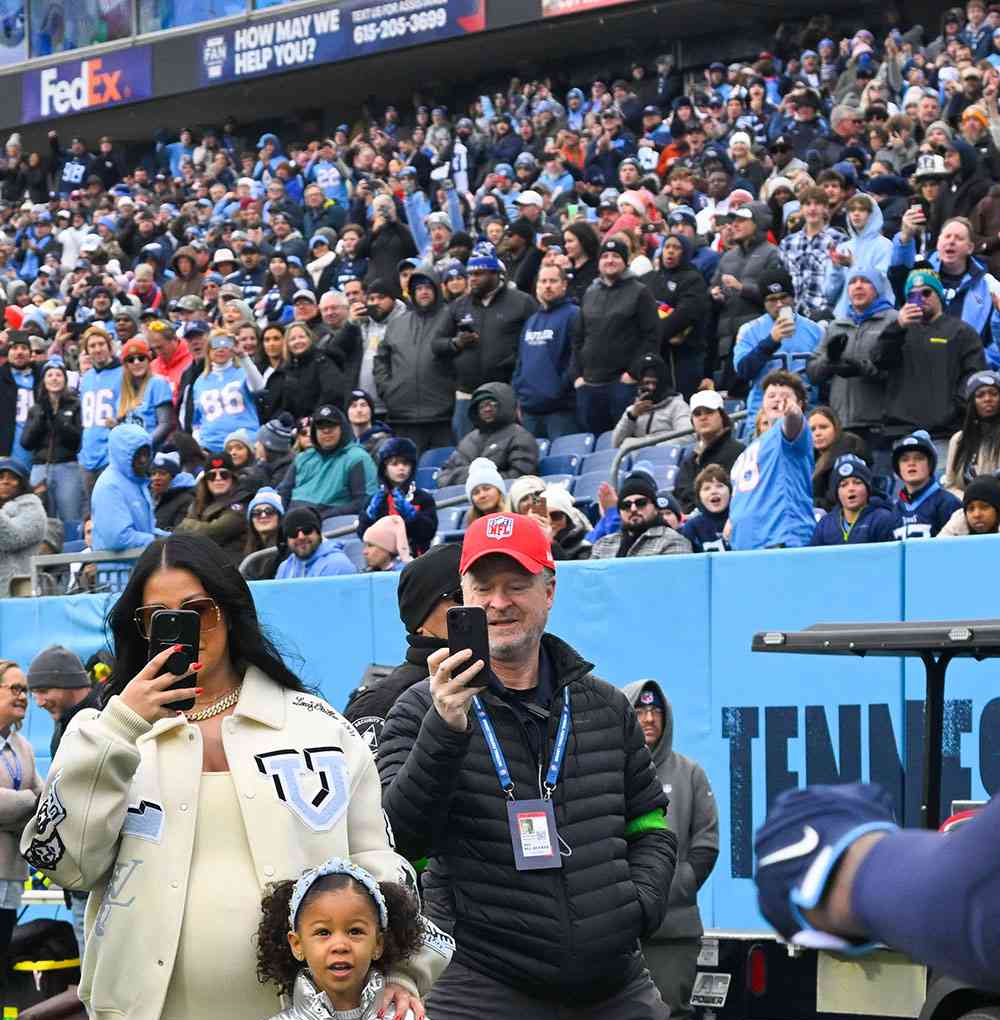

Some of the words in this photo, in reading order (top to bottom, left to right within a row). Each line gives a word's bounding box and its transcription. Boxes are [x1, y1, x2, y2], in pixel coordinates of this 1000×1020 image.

[235, 23, 275, 51] HOW
[276, 15, 312, 42] MAY
[313, 9, 340, 34] WE
[235, 48, 273, 74] HELP
[274, 38, 316, 66] YOU?
[41, 58, 123, 116] FedEx
[488, 524, 511, 536] NFL
